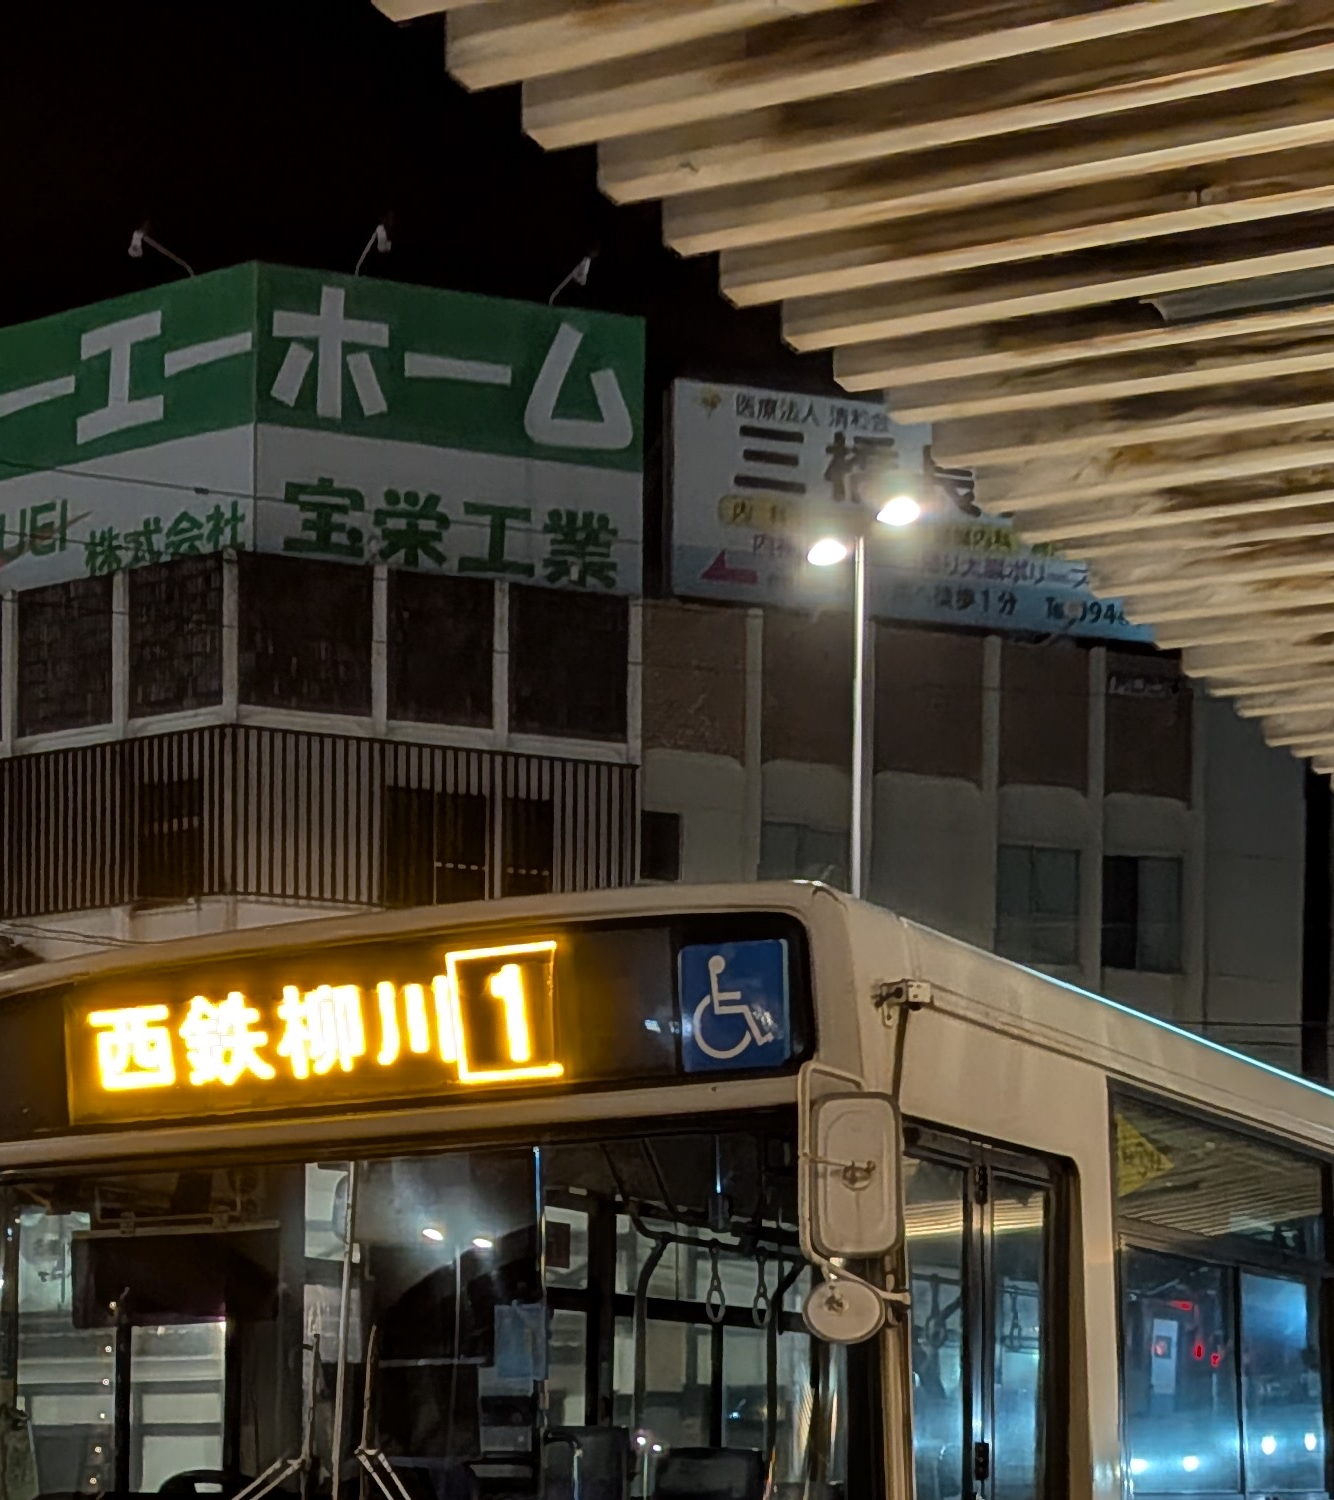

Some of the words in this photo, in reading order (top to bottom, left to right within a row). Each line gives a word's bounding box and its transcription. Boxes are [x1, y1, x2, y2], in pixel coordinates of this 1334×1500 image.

[270, 284, 633, 450] ホーム
[84, 500, 245, 576] 株式会社
[283, 478, 618, 588] 宝栄工業
[88, 975, 458, 1091] 西鉄柳川
[490, 963, 532, 1063] 1
